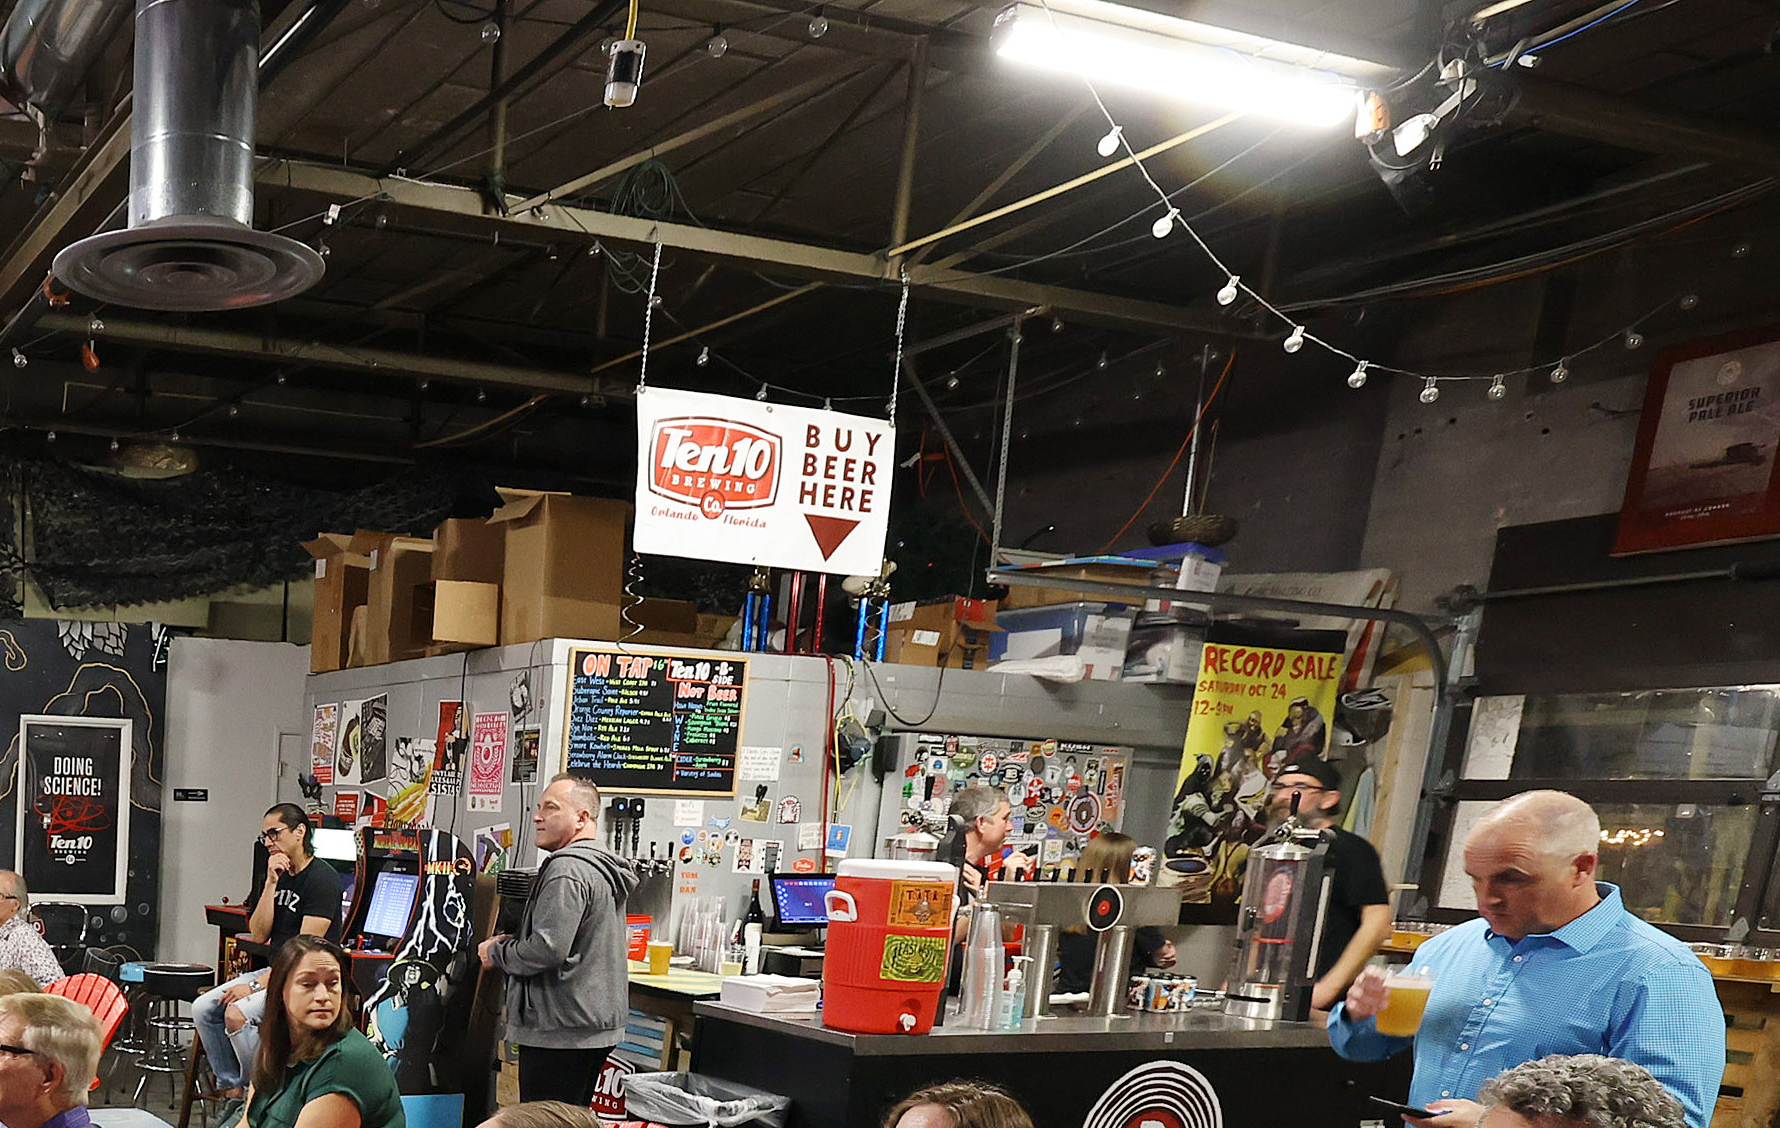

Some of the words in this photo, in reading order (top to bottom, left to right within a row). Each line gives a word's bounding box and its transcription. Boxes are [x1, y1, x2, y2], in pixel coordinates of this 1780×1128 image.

[1688, 386, 1761, 411] SUPERIOR
[1688, 406, 1722, 424] PALE
[1726, 400, 1756, 417] ALE
[806, 424, 882, 456] BUY
[660, 427, 772, 480] Ten10
[802, 452, 877, 485] BEER
[671, 474, 756, 494] BREWING
[799, 481, 873, 513] HERE
[651, 506, 699, 521] Orlando
[582, 653, 611, 678] ON
[616, 655, 653, 679] TAP
[671, 660, 711, 681] Ten10
[1203, 645, 1286, 680] RECORD
[1289, 654, 1338, 681] SALE
[711, 674, 734, 686] SIDE
[1197, 680, 1246, 697] SATURDAY
[1249, 684, 1267, 697] OCT
[1271, 682, 1287, 699] 24
[54, 757, 93, 776] DOING
[43, 776, 102, 796] SCIENCE!
[50, 834, 93, 850] Ten10
[426, 861, 451, 875] MKII
